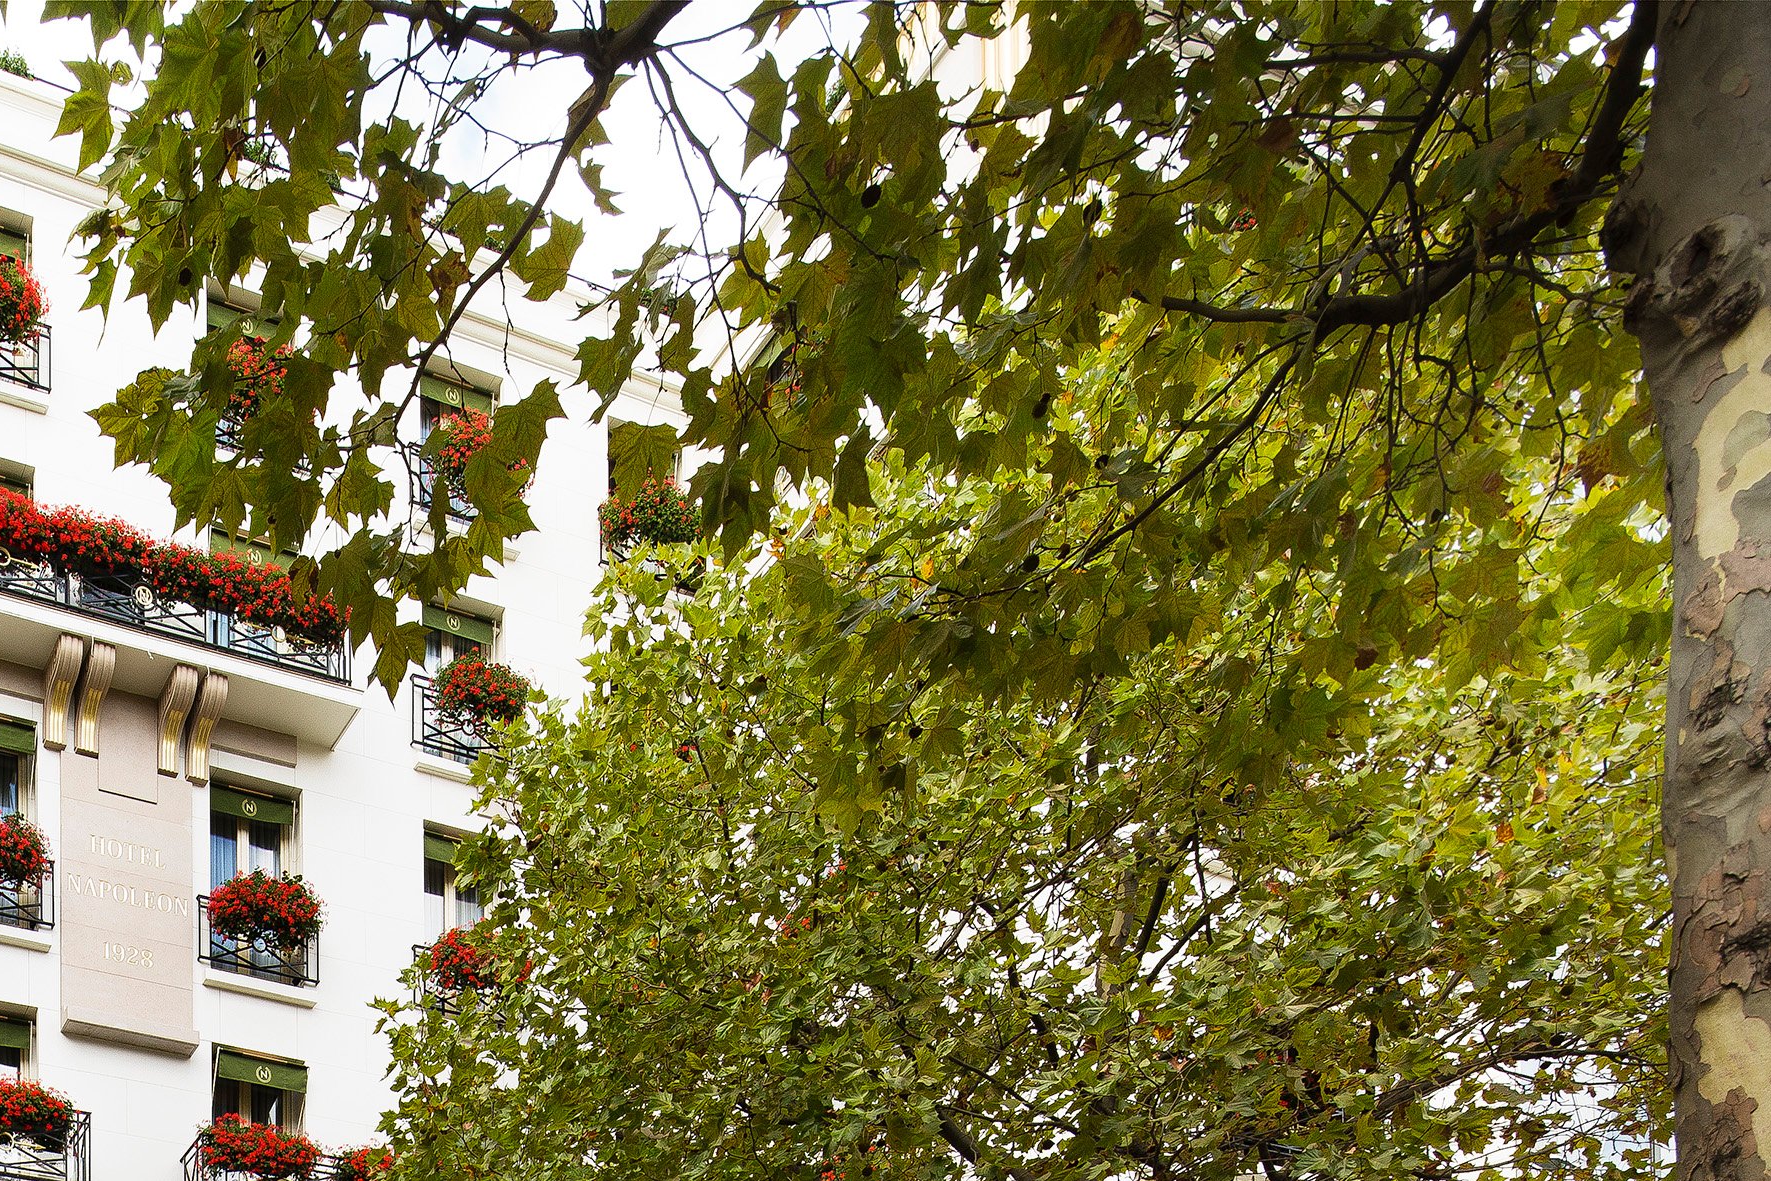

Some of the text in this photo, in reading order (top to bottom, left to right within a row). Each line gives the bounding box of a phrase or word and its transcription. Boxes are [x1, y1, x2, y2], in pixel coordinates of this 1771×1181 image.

[449, 391, 456, 400] N
[450, 618, 457, 627] N
[246, 802, 253, 812] N
[90, 834, 166, 870] HOTEL
[67, 872, 189, 918] NAPOLEON
[103, 941, 154, 969] 1928
[260, 1069, 268, 1079] N
